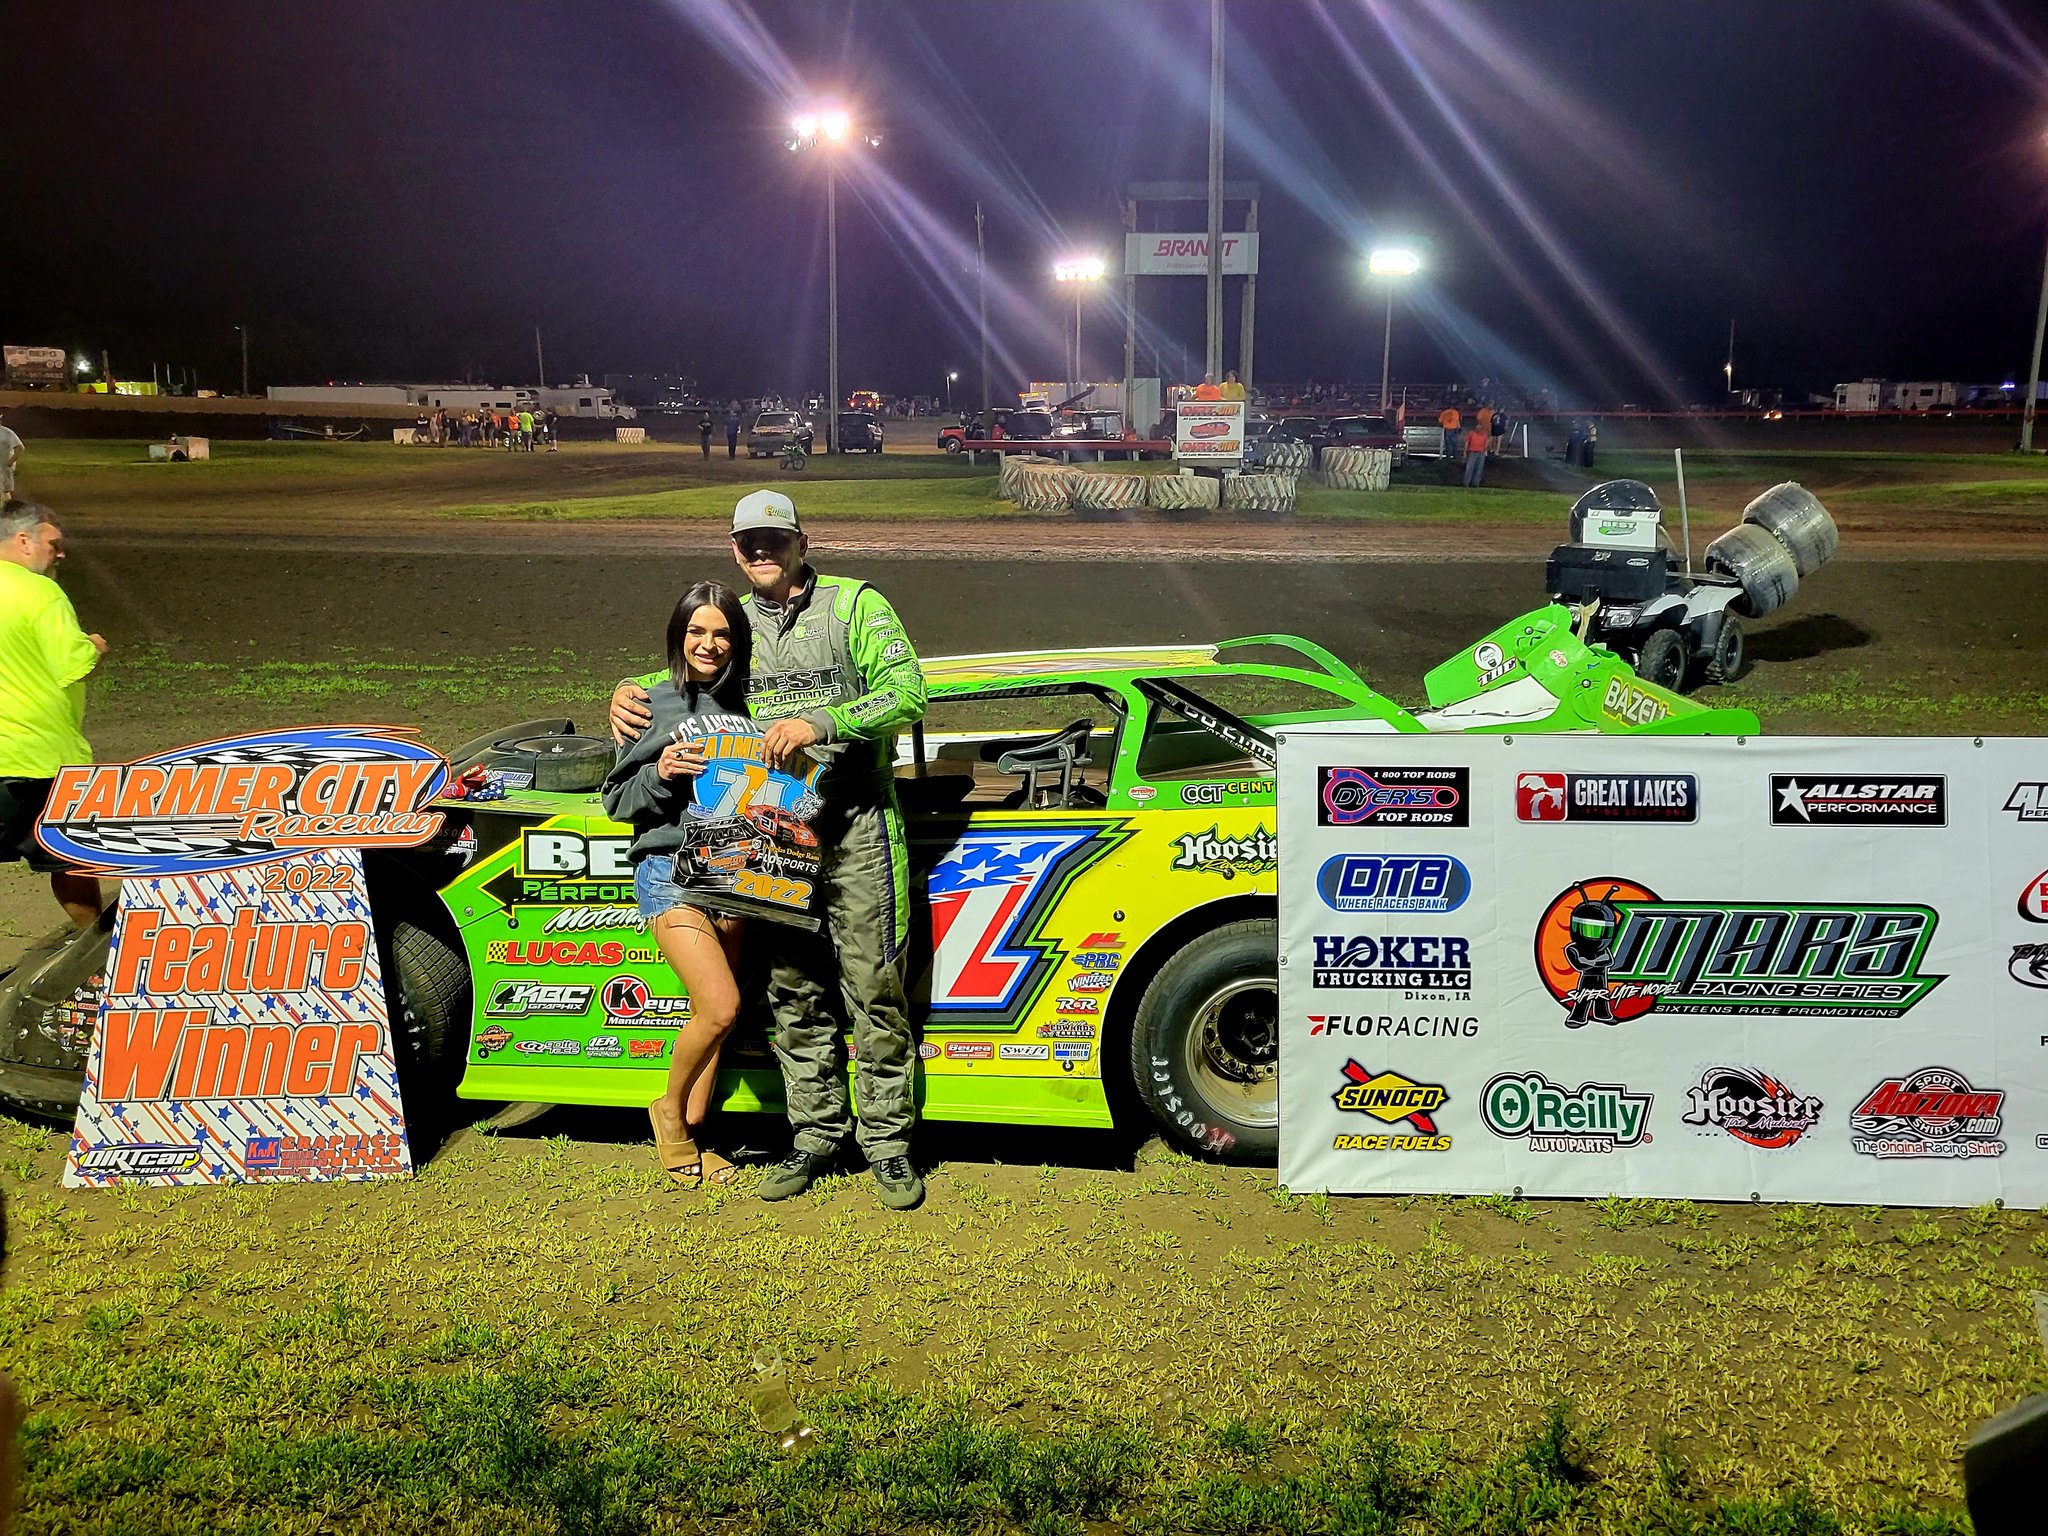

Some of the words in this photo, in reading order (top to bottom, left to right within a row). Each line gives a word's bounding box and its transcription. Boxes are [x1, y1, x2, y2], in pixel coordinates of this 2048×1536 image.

[1153, 240, 1239, 256] BRANT
[741, 665, 842, 696] BEST
[747, 686, 842, 705] PERFORMANCE
[42, 766, 297, 823] FARMER
[297, 760, 440, 815] CITY
[1181, 783, 1226, 804] CCT
[1334, 788, 1435, 806] DYER'S
[1575, 780, 1628, 806] GREAT
[1634, 780, 1687, 807] LAKES
[1804, 785, 1937, 799] ALLSTAR
[1377, 813, 1407, 822] TOP
[1412, 813, 1453, 822] RODS
[1808, 803, 1937, 814] PERFORMANCE
[237, 809, 446, 842] Raceway
[756, 852, 818, 873] FLOSPORTS
[786, 849, 805, 859] Dodge
[262, 865, 355, 892] 2022
[1338, 858, 1451, 897] DTB
[732, 870, 812, 909] 2022
[1338, 899, 1374, 909] WHERE
[1375, 899, 1416, 909] RACERS
[1417, 899, 1447, 910] BANK
[110, 907, 371, 996] Feature
[506, 942, 624, 965] LUCAS
[628, 949, 651, 961] OIL
[1313, 936, 1471, 968] HOKER
[1609, 910, 1926, 980] MARS
[1083, 953, 1121, 968] PRC
[1317, 973, 1423, 986] TRUCKING
[1429, 974, 1468, 987] LLC
[610, 983, 691, 1011] Keys
[1405, 991, 1450, 1002] Dixon,
[1456, 992, 1471, 1001] IA
[1561, 989, 1609, 1003] SUPER
[1610, 983, 1641, 1010] LATE
[1640, 982, 1682, 997] MODEL
[1689, 983, 1800, 996] RACING
[1801, 984, 1904, 999] SERIES
[1655, 1005, 1732, 1014] SIXTEENS
[1739, 1007, 1780, 1015] RACE
[1791, 1007, 1900, 1017] PROMOTIONS
[1326, 1016, 1480, 1037] FLORACING
[96, 1007, 384, 1102] Winner
[1001, 1046, 1047, 1056] Swift
[1915, 1075, 1961, 1090] SPORT
[1342, 1089, 1439, 1107] SUNOCO
[1491, 1078, 1641, 1136] O'Reilly
[1684, 1085, 1822, 1124] Hoosier
[1857, 1082, 2001, 1117] ARIZONA
[1912, 1118, 1960, 1135] SHIRTS
[281, 1134, 400, 1150] GRAPHICS
[1334, 1136, 1390, 1150] RACE
[1391, 1136, 1451, 1150] FUELS
[1530, 1138, 1566, 1152] AUTO
[1567, 1138, 1613, 1153] PARTS
[83, 1148, 197, 1171] DIRTcar
